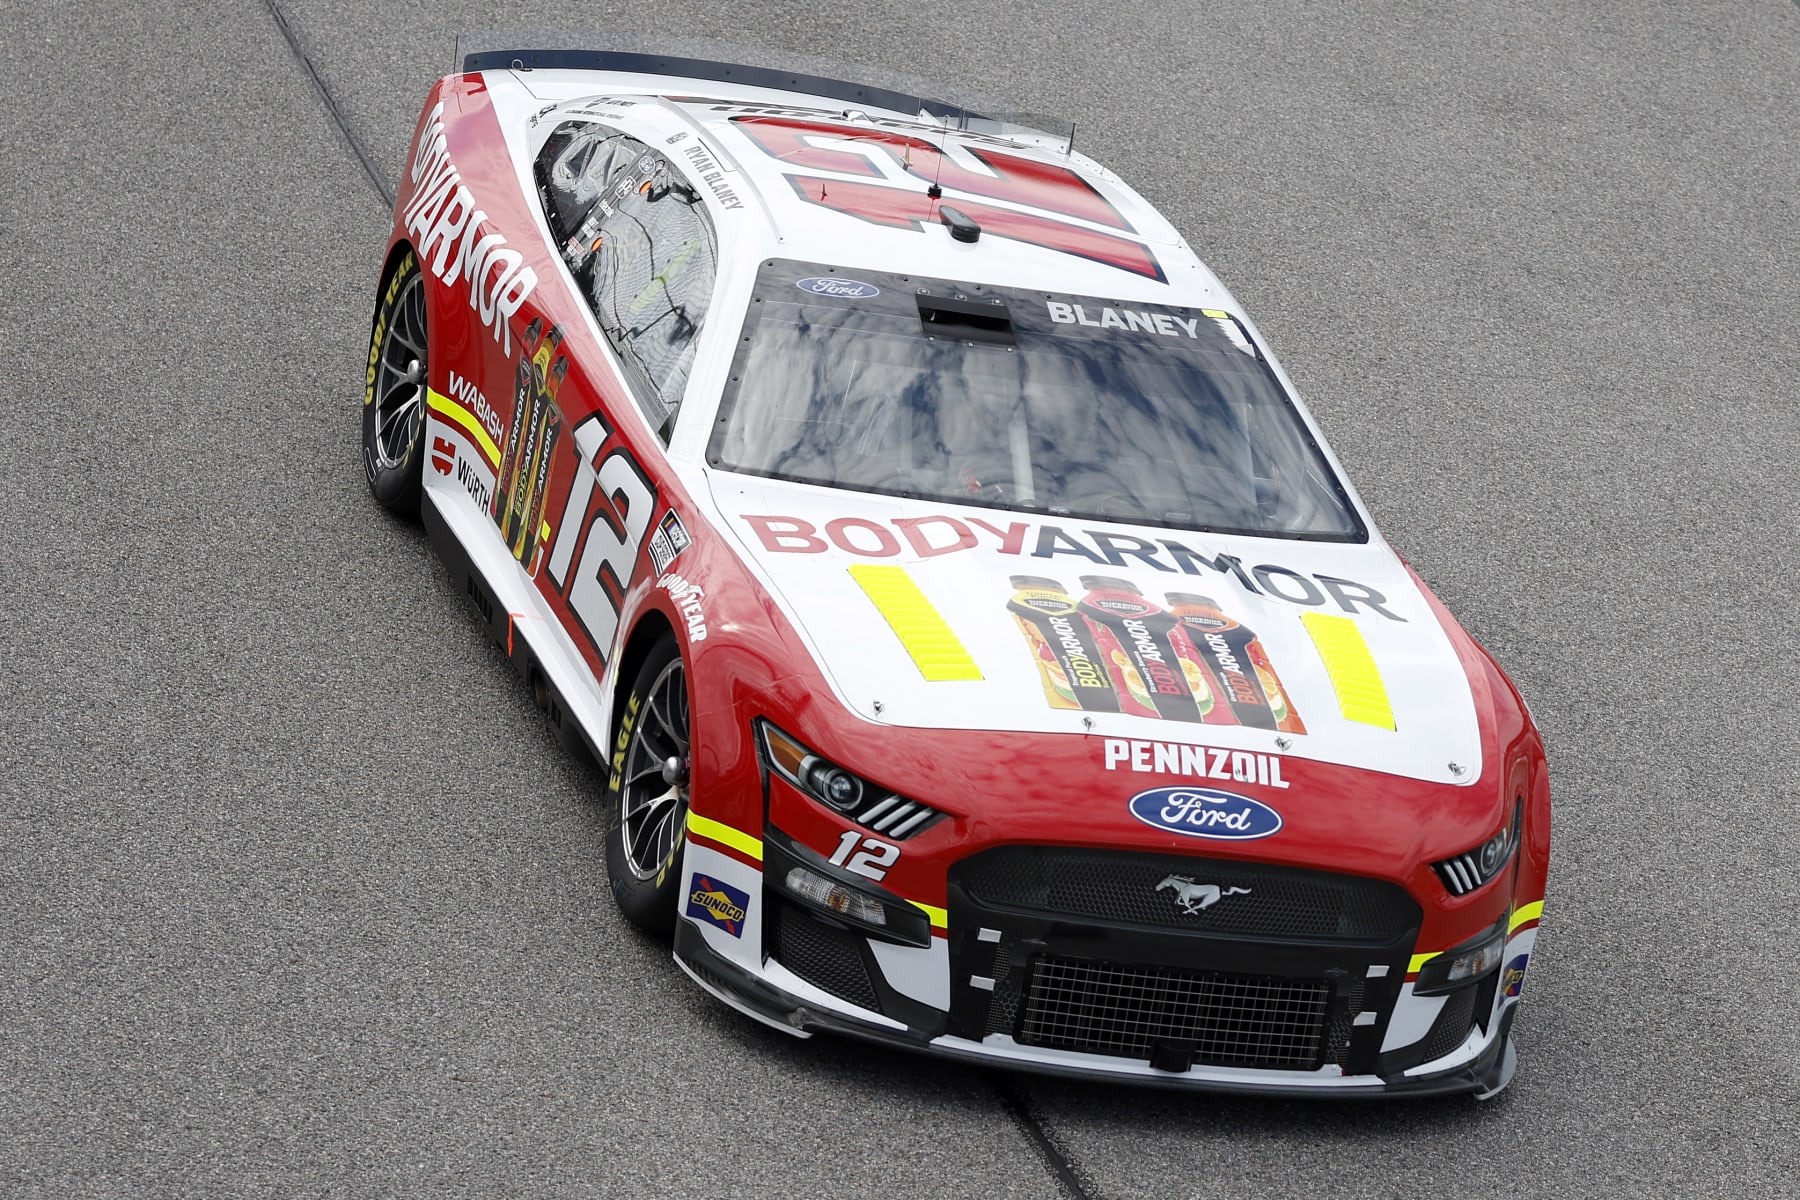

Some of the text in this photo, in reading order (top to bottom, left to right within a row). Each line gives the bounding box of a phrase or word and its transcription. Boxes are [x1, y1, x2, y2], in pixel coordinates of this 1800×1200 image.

[683, 145, 744, 210] RYAN BLANEY
[402, 101, 539, 359] BODYARMOR
[1046, 300, 1198, 339] BLANEY
[449, 370, 504, 445] WABASH
[457, 455, 491, 517] WÜRTH
[514, 399, 540, 518] BODYARMOR
[547, 411, 656, 667] 12
[740, 514, 1409, 623] BODYARMOR
[655, 572, 708, 643] GOODYEAR
[1048, 616, 1102, 688] BODYARMOR
[1122, 619, 1182, 695] BODYARMOR
[1203, 633, 1258, 705] BODYARMOR
[608, 689, 640, 793] EAGLE
[1104, 738, 1290, 789] PENNZOIL
[1160, 791, 1252, 831] Ford
[827, 830, 901, 882] 12
[693, 892, 743, 921] SUNOCO
